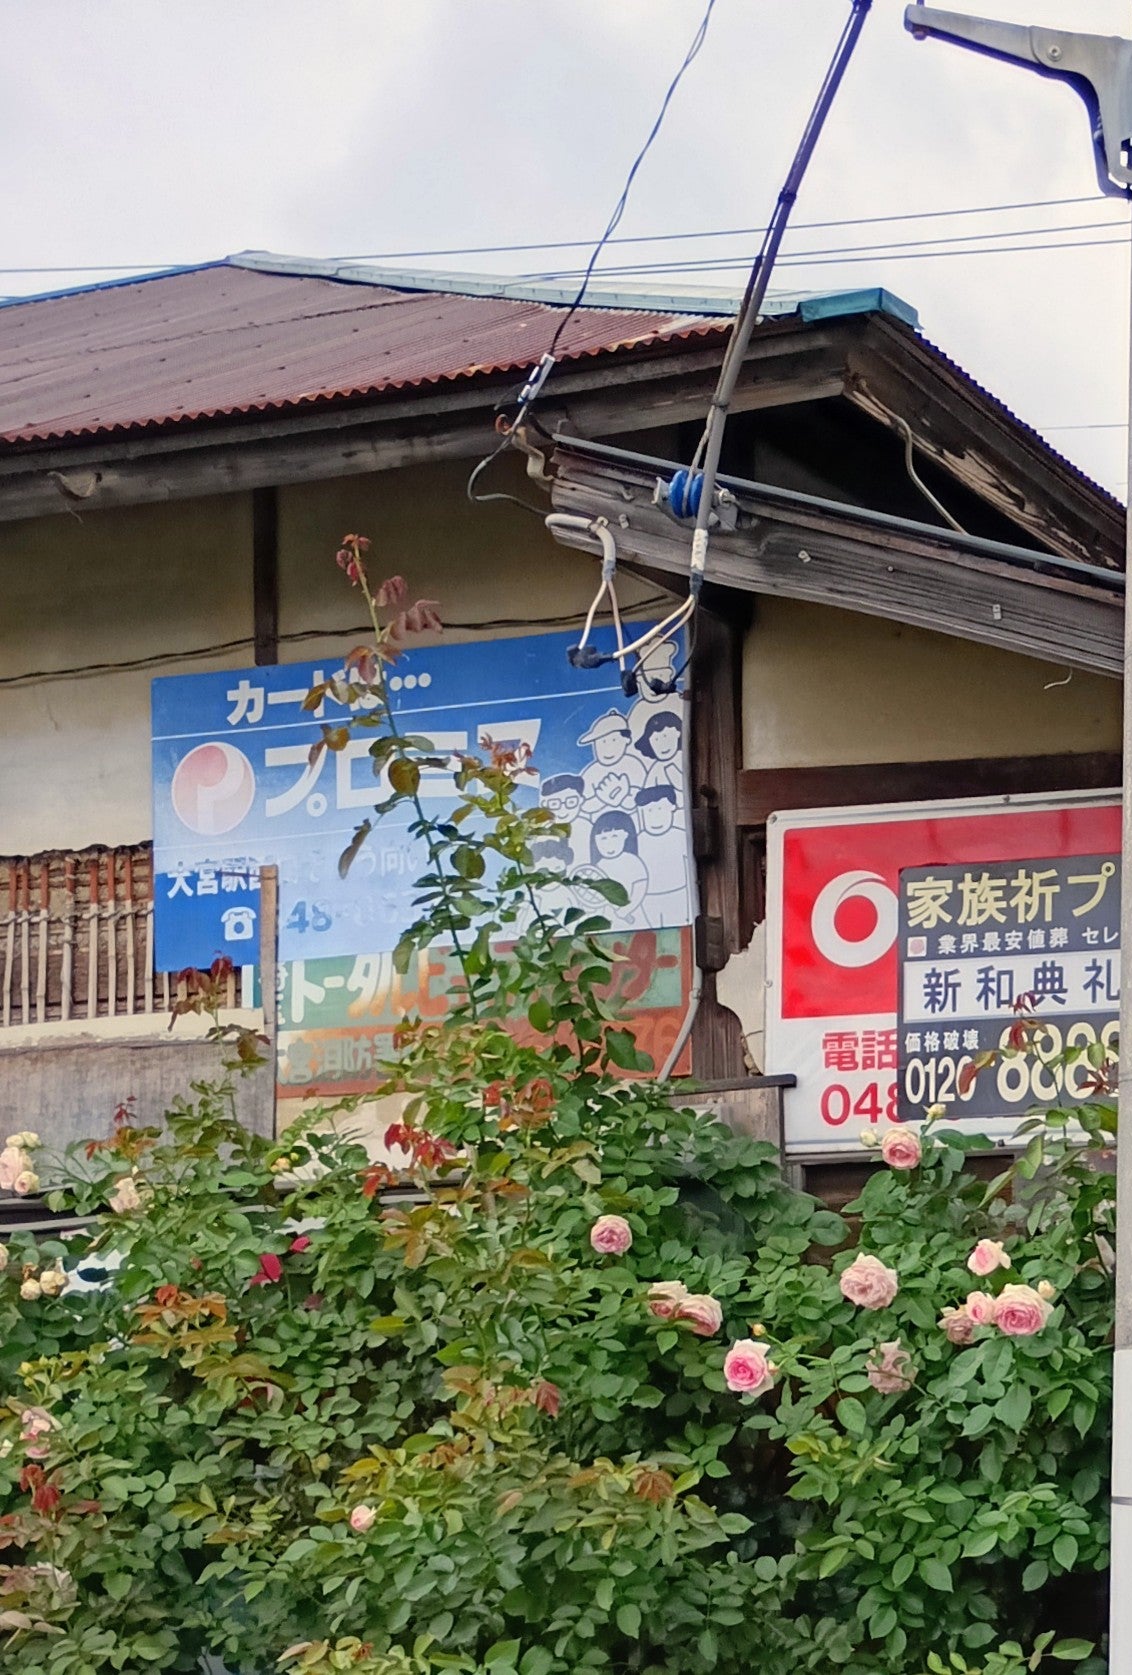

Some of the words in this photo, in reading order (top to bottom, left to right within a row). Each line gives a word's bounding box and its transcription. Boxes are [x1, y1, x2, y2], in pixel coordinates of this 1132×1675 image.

[905, 861, 1116, 929] 家族祈プ
[922, 957, 1121, 1014] 新和典礼
[822, 1029, 897, 1072] 電話
[905, 1029, 979, 1054] 価格破壊
[905, 1056, 977, 1103] 0120
